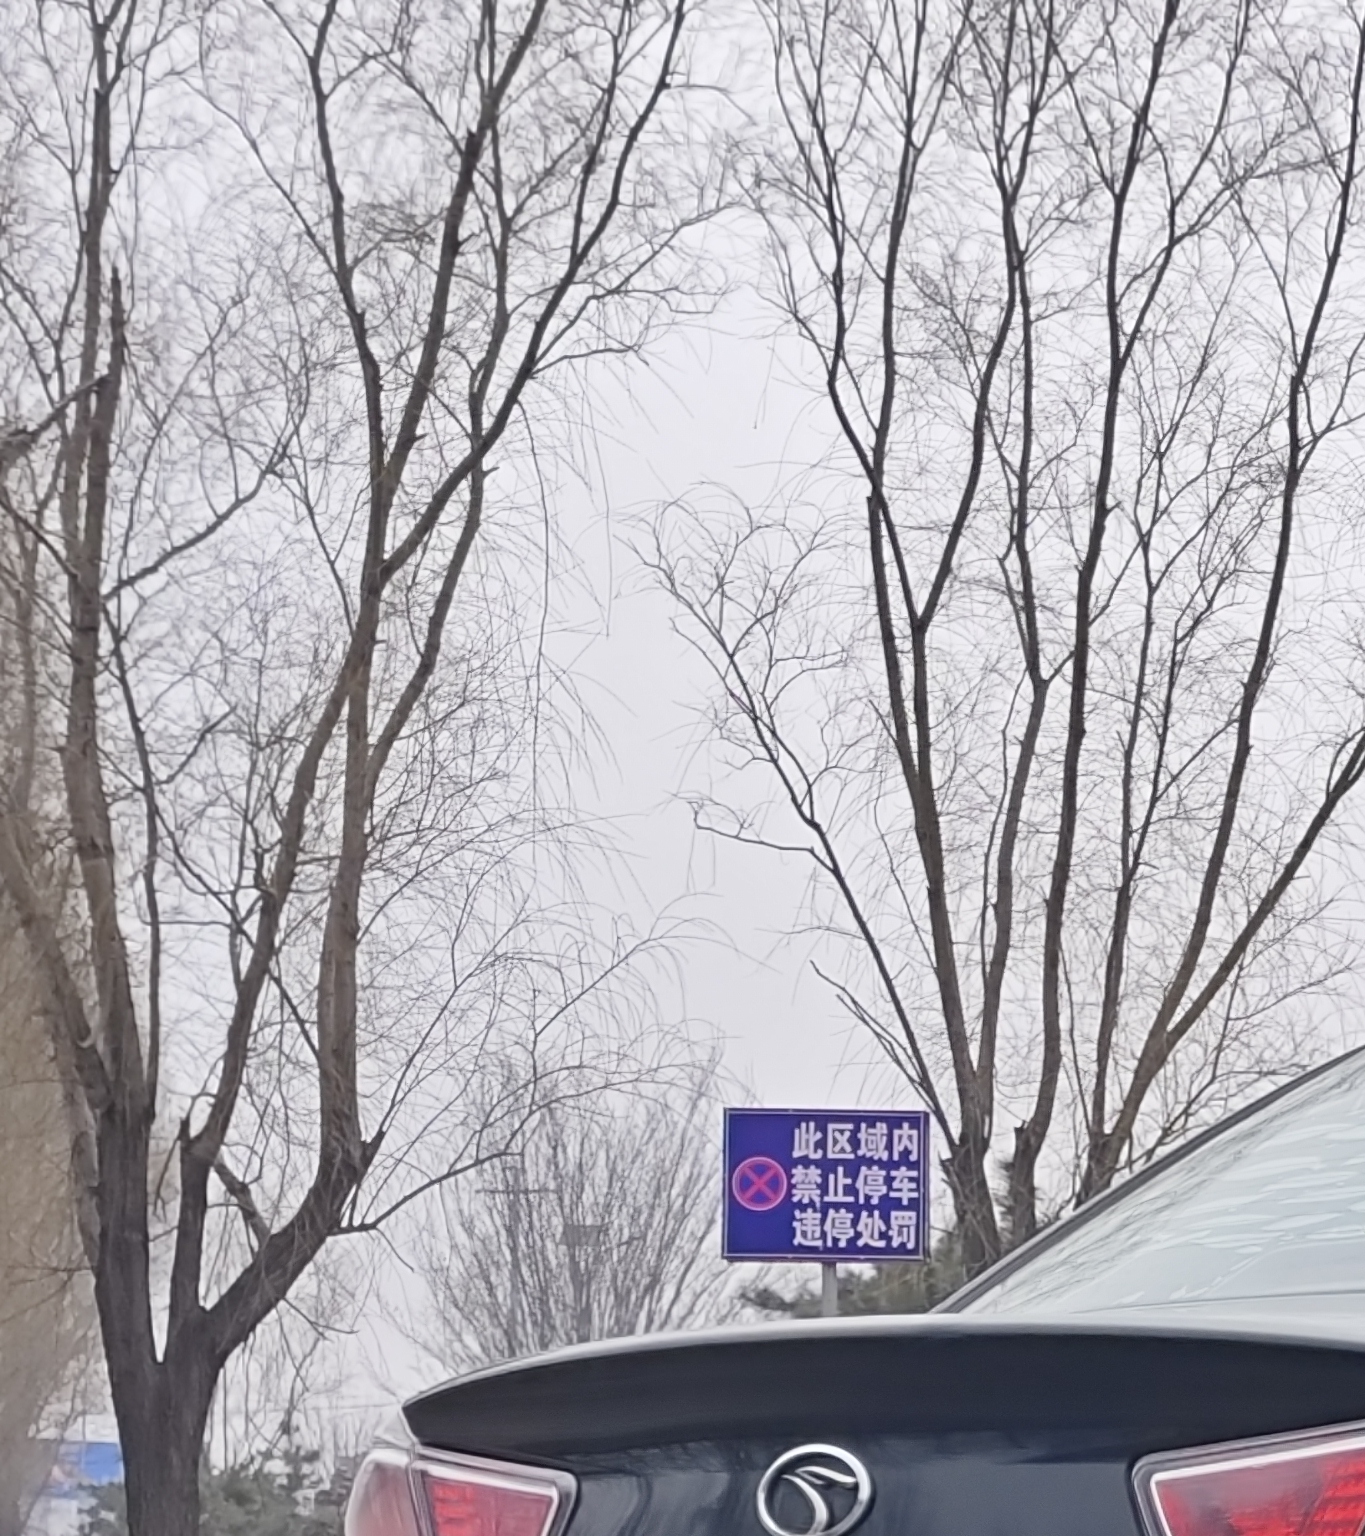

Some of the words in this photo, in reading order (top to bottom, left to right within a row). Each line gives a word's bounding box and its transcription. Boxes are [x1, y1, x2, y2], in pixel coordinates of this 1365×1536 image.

[792, 1121, 919, 1162] 此区域内
[790, 1164, 920, 1206] 禁止停车
[791, 1207, 918, 1250] 违停处罚
